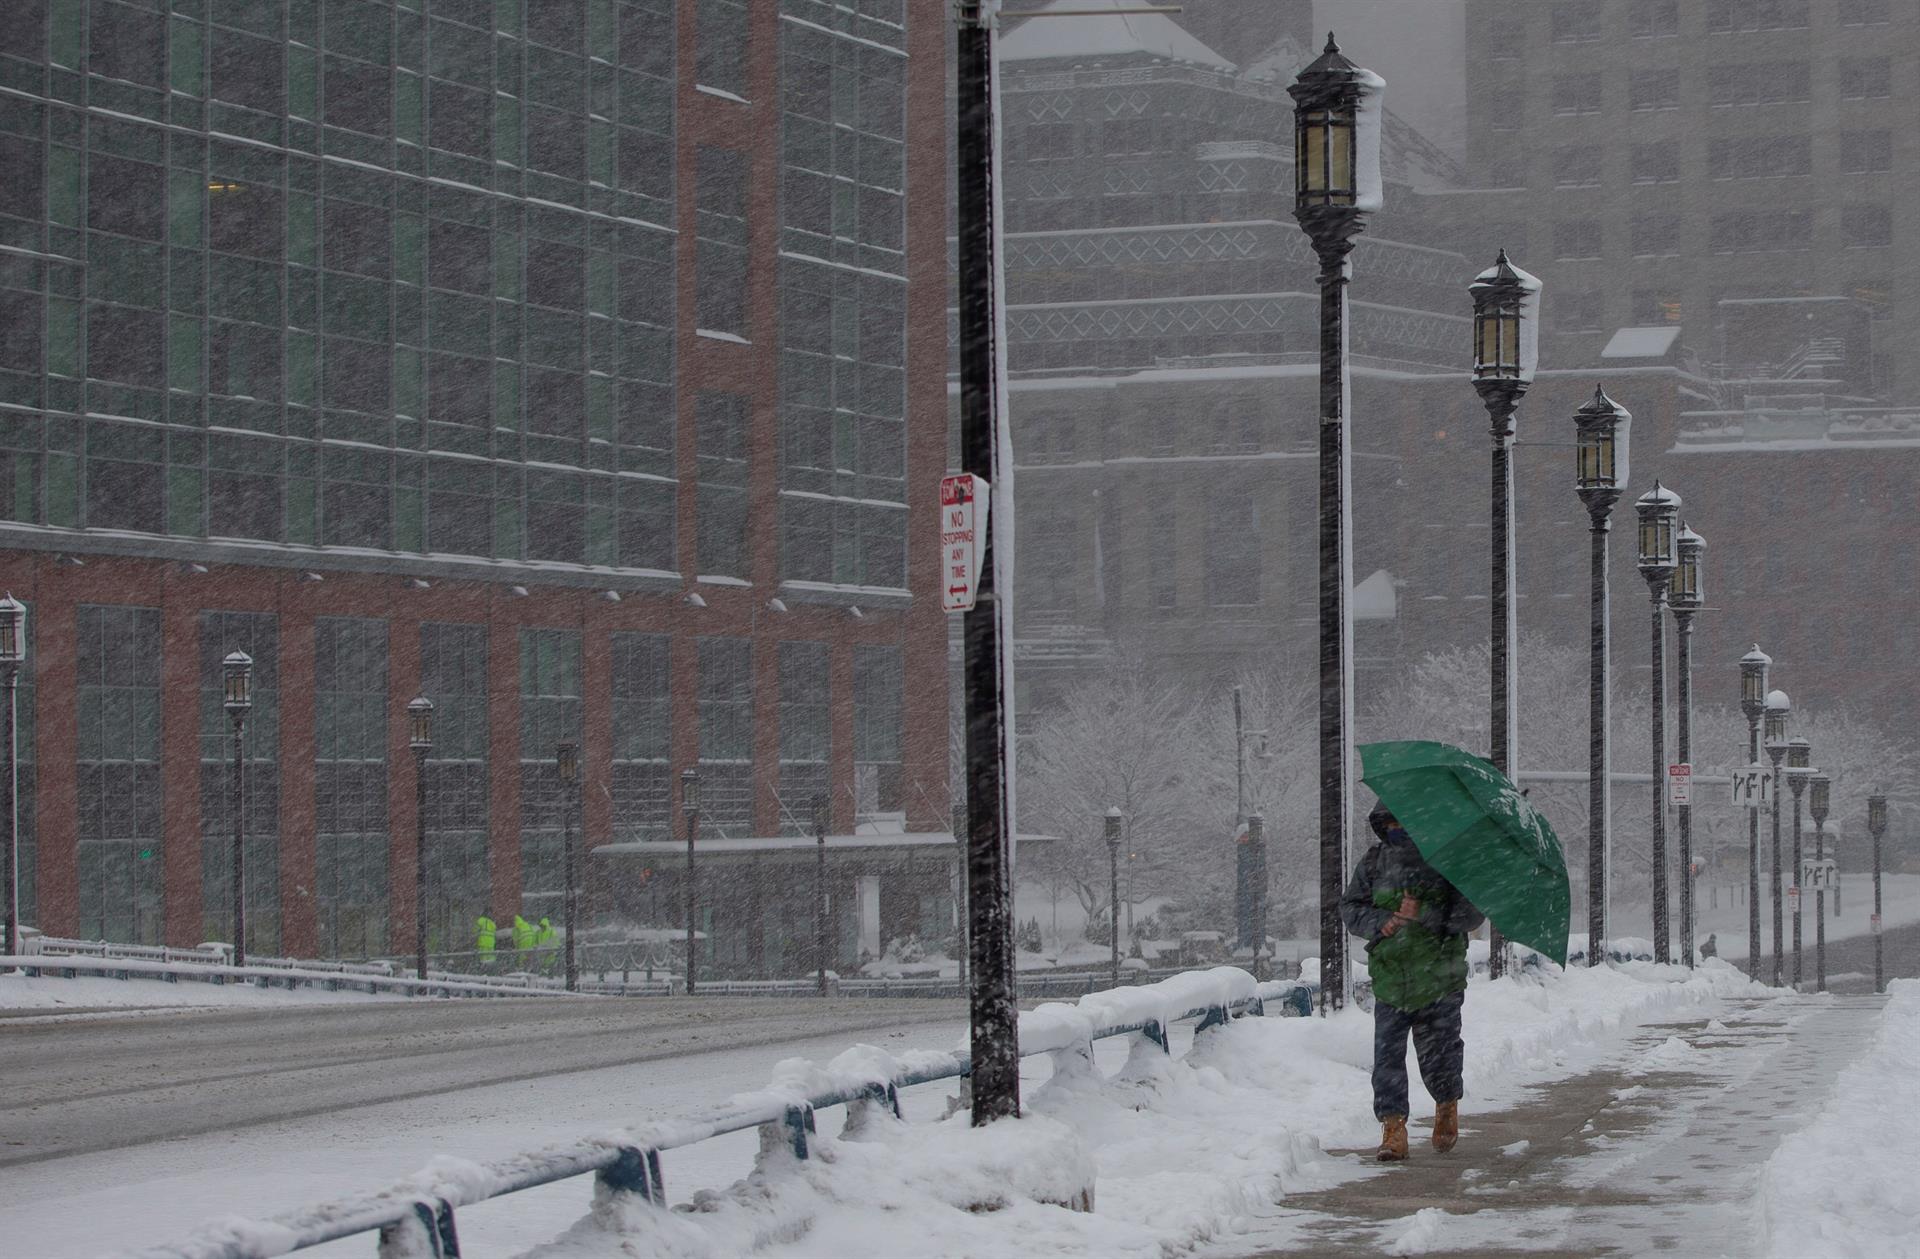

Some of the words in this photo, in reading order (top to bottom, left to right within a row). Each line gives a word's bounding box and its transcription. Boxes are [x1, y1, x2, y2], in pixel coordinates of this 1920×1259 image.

[951, 511, 964, 527] NO
[943, 530, 973, 545] STOPPING
[952, 548, 964, 561] ANY
[952, 565, 966, 579] TIME
